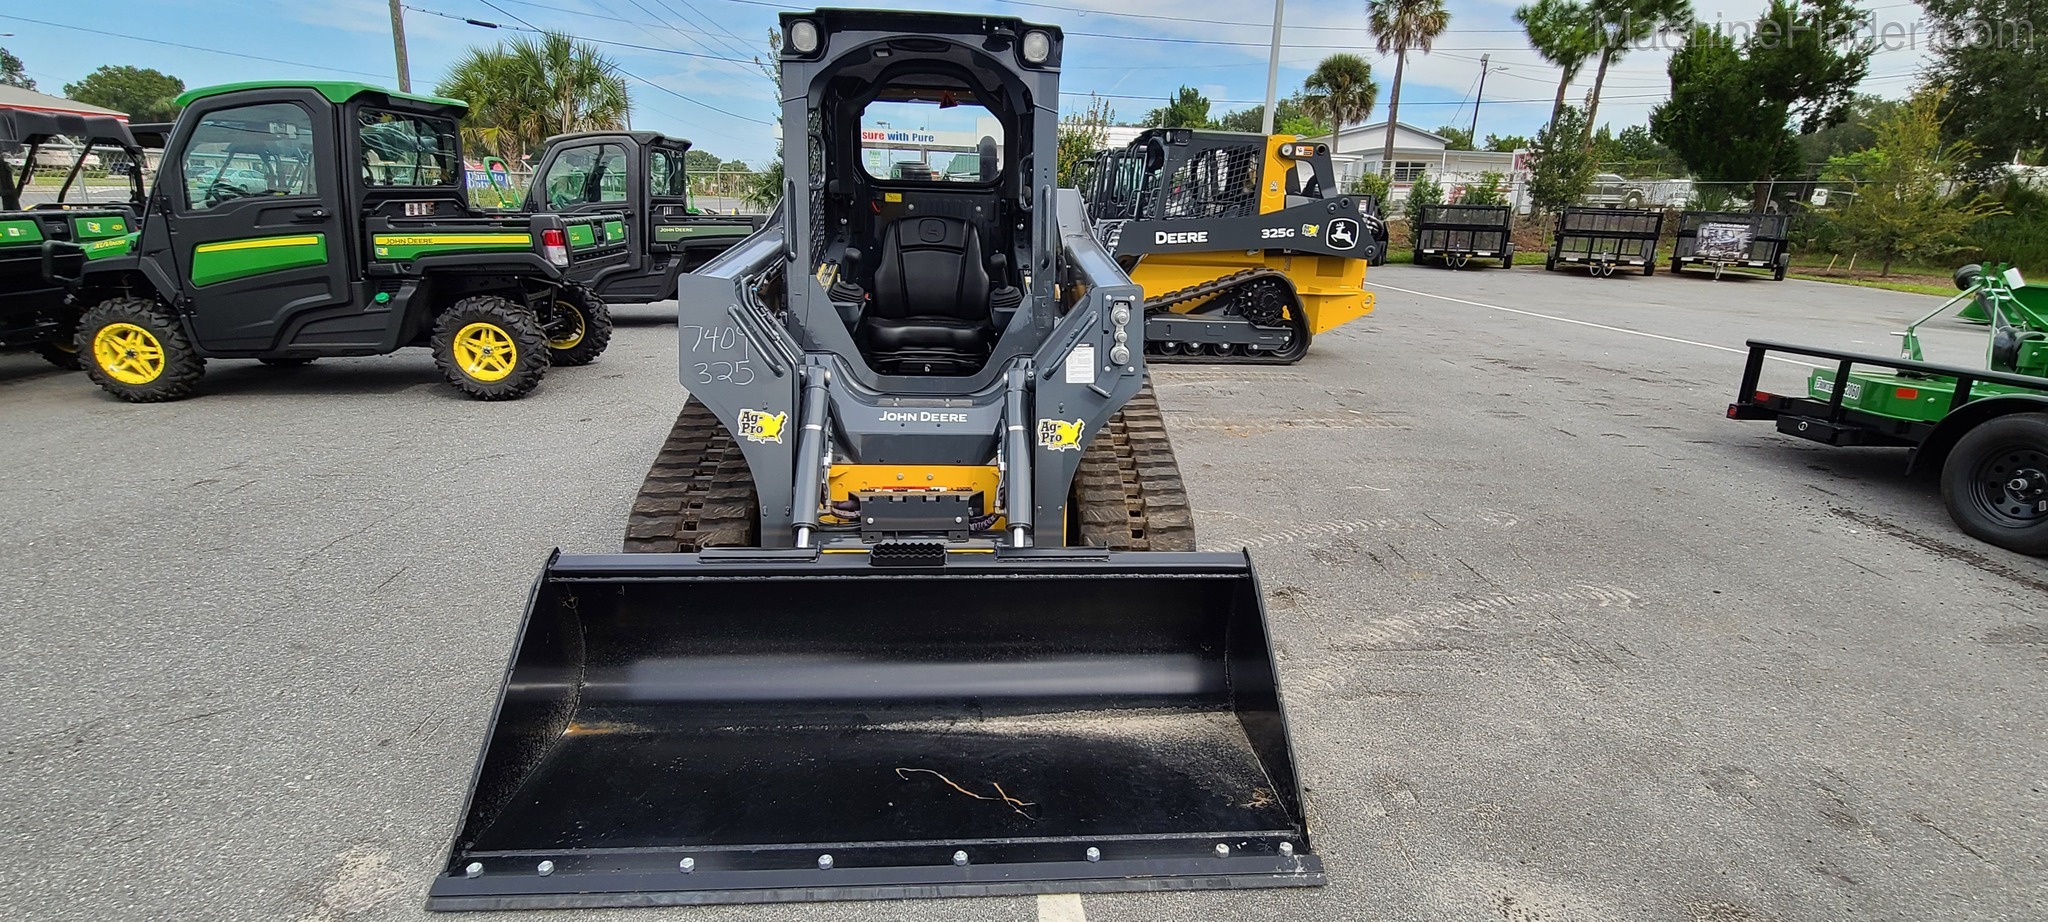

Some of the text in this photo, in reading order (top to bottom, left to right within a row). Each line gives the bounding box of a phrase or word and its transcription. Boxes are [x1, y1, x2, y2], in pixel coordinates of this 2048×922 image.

[862, 131, 935, 143] sure with Pure
[1155, 231, 1208, 245] DEERE
[1261, 228, 1295, 239] 325G
[683, 324, 749, 360] 7409
[694, 360, 755, 386] 325
[741, 411, 763, 425] Ag-
[878, 411, 968, 423] JOHN DEERE
[741, 422, 764, 434] Pro
[1041, 421, 1062, 434] Ag-
[1041, 432, 1063, 443] Pro
